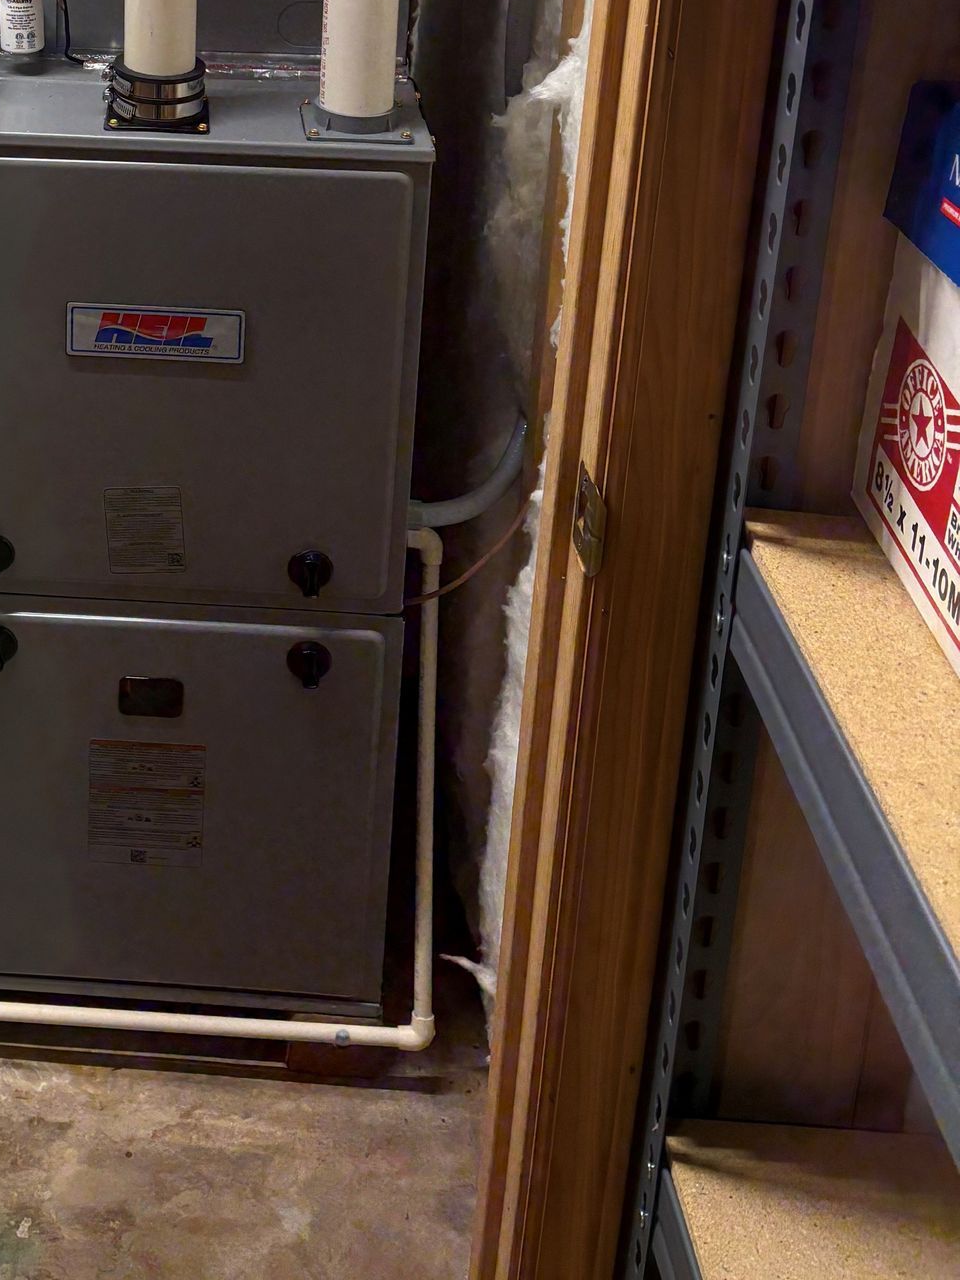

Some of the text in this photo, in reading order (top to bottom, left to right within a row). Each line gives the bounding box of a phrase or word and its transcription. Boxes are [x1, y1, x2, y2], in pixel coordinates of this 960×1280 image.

[94, 343, 126, 351] HEATING
[134, 345, 167, 353] COOLING
[168, 347, 210, 355] PRODUCTS
[95, 312, 214, 348] HEIL
[902, 365, 943, 416] OFFICE
[900, 428, 945, 484] AMERICA
